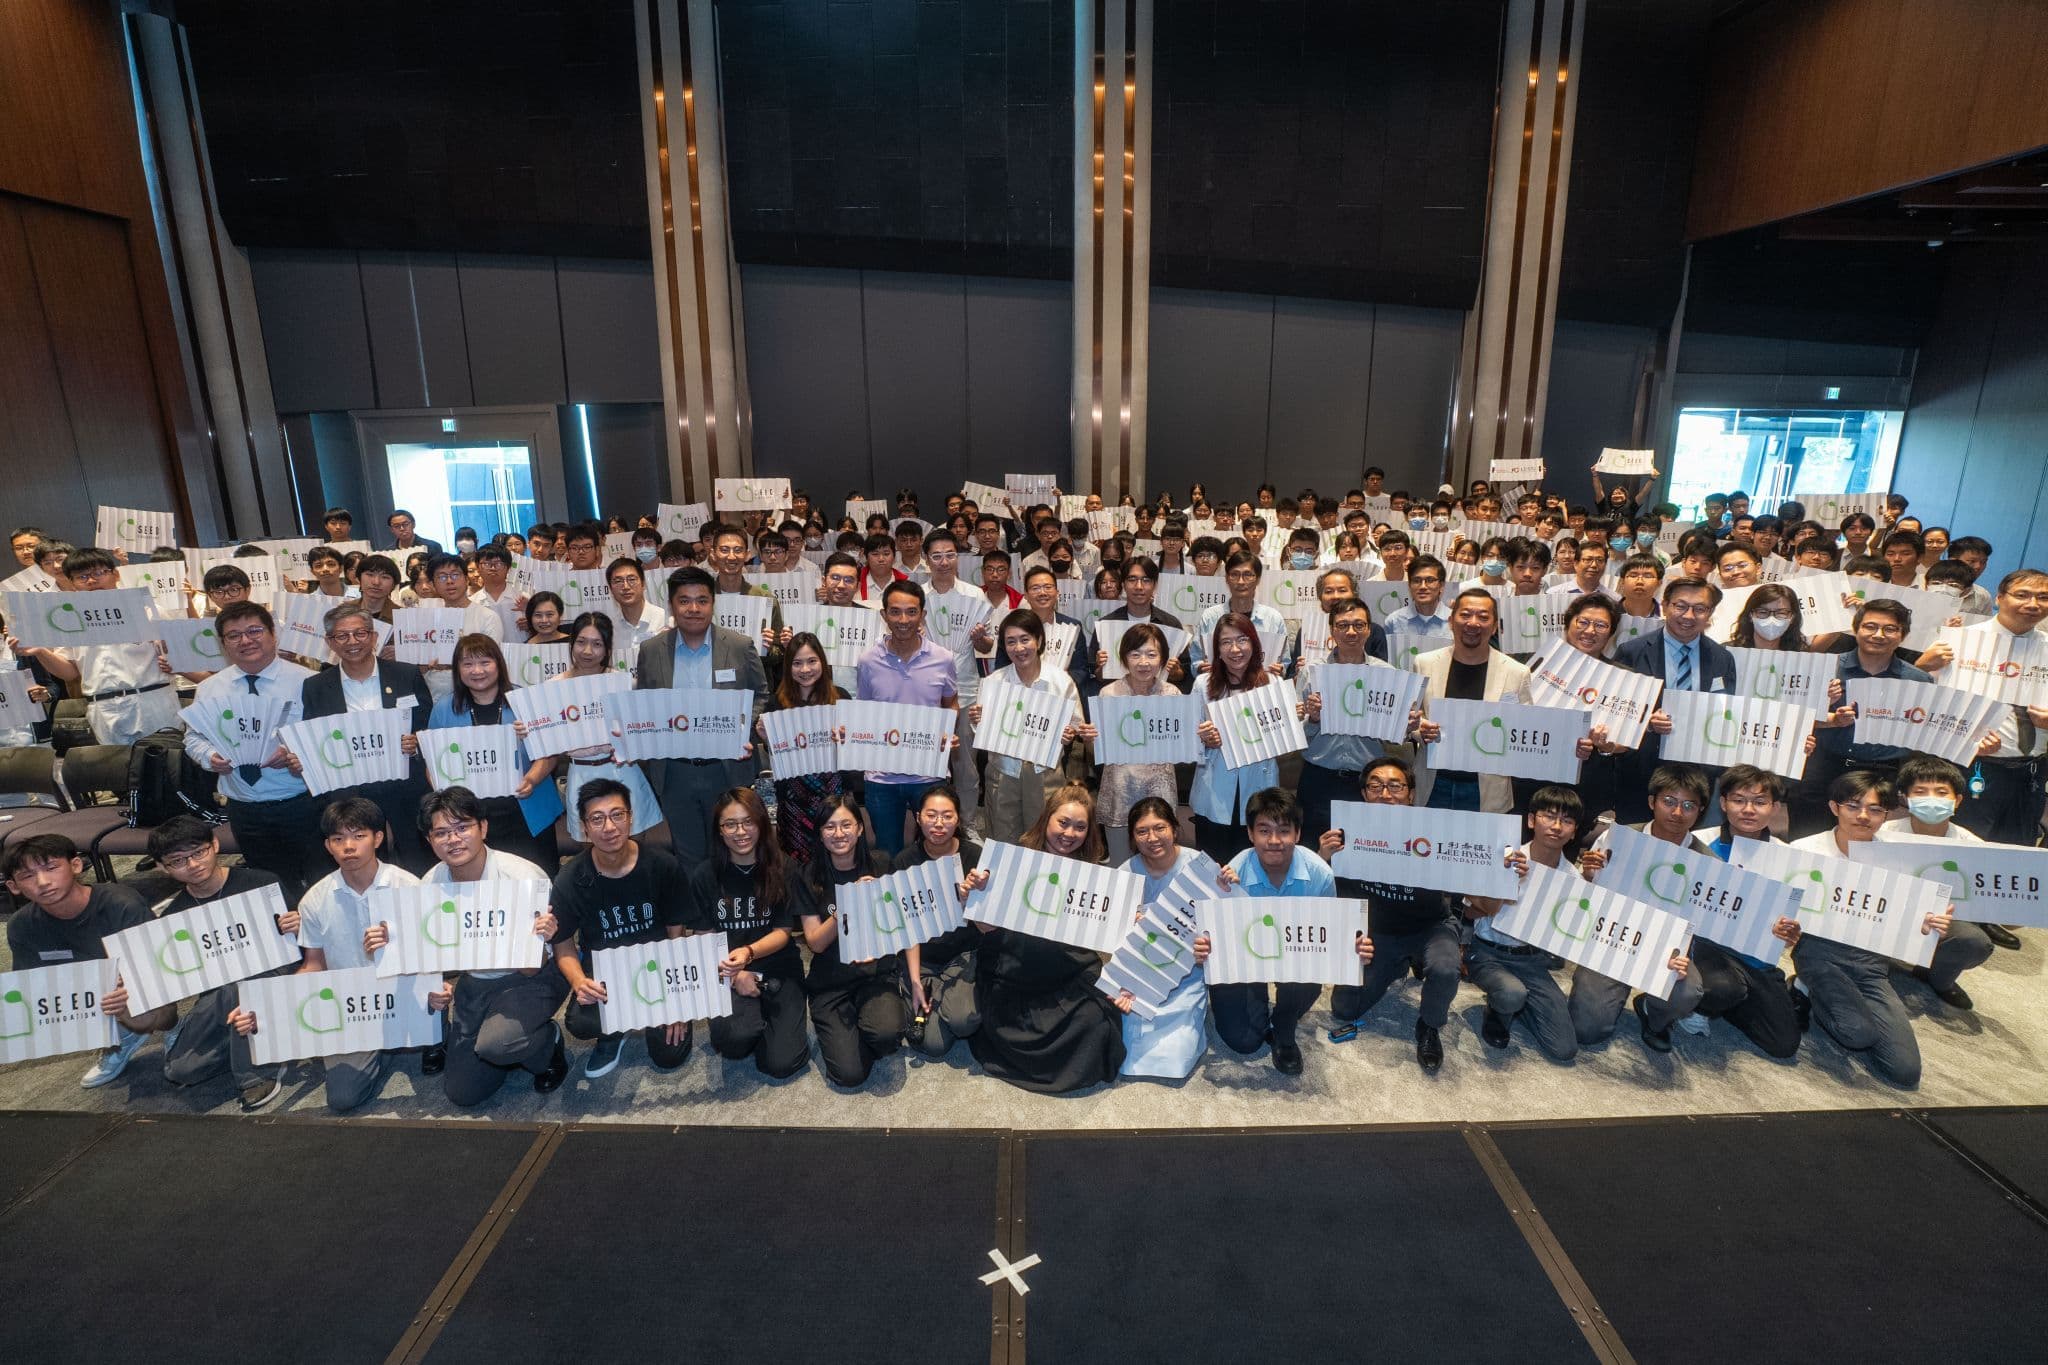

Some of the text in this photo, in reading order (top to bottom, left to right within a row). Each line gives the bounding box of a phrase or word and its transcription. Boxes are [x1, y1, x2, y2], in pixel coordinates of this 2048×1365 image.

[1840, 505, 1864, 513] SEED
[137, 524, 160, 535] SEED
[249, 570, 269, 583] EED
[1760, 573, 1778, 582] SEE
[583, 585, 610, 597] SEED
[774, 588, 799, 599] SEED
[1199, 592, 1226, 604] SEED
[1297, 586, 1316, 597] SEE
[83, 607, 123, 621] SEED
[720, 614, 746, 628] SEED
[840, 626, 867, 640] SEED
[544, 662, 567, 675] SEED
[1780, 674, 1810, 689] SEED
[1368, 690, 1395, 708] SEED
[1577, 686, 1598, 705] 10
[559, 704, 581, 722] 10
[1025, 712, 1050, 732] SEED
[1257, 707, 1283, 727] SEED
[1903, 706, 1926, 724] 10
[626, 721, 656, 730] ALIBABA
[667, 714, 689, 732] 10
[1149, 717, 1180, 733] SEED
[1741, 721, 1781, 741] SEED
[352, 733, 385, 751] SEED
[850, 732, 875, 740] ALIBABA
[883, 728, 900, 747] 10
[1510, 728, 1551, 747] SEED
[466, 749, 497, 766] SEED
[1353, 838, 1389, 849] ALIBABA
[1402, 836, 1432, 858] 10
[1436, 841, 1493, 860] LEE HYSAN
[1435, 854, 1493, 867] FOUNDATION
[1974, 872, 2041, 893] SEED
[900, 887, 936, 913] SEED
[1065, 887, 1111, 914] SEED
[1691, 881, 1744, 913] SEED
[1832, 886, 1888, 914] SEED
[1974, 890, 2040, 901] FOUNDATION
[598, 902, 654, 931] SEED
[716, 895, 773, 921] SEED
[1688, 897, 1739, 921] FOUNDATION
[1829, 903, 1884, 924] FOUNDATION
[464, 909, 506, 929] SEED
[201, 922, 248, 950] SEED
[602, 919, 654, 941] FOUNDATION
[1284, 925, 1328, 943] SEED
[1595, 915, 1643, 947] SEED
[1284, 945, 1328, 953] FOUNDATION
[664, 964, 699, 985] SEED
[37, 990, 95, 1016] SEED
[346, 992, 395, 1014] SEED
[38, 1011, 97, 1027] FOUNDATION
[347, 1012, 397, 1024] FOUNDATION
